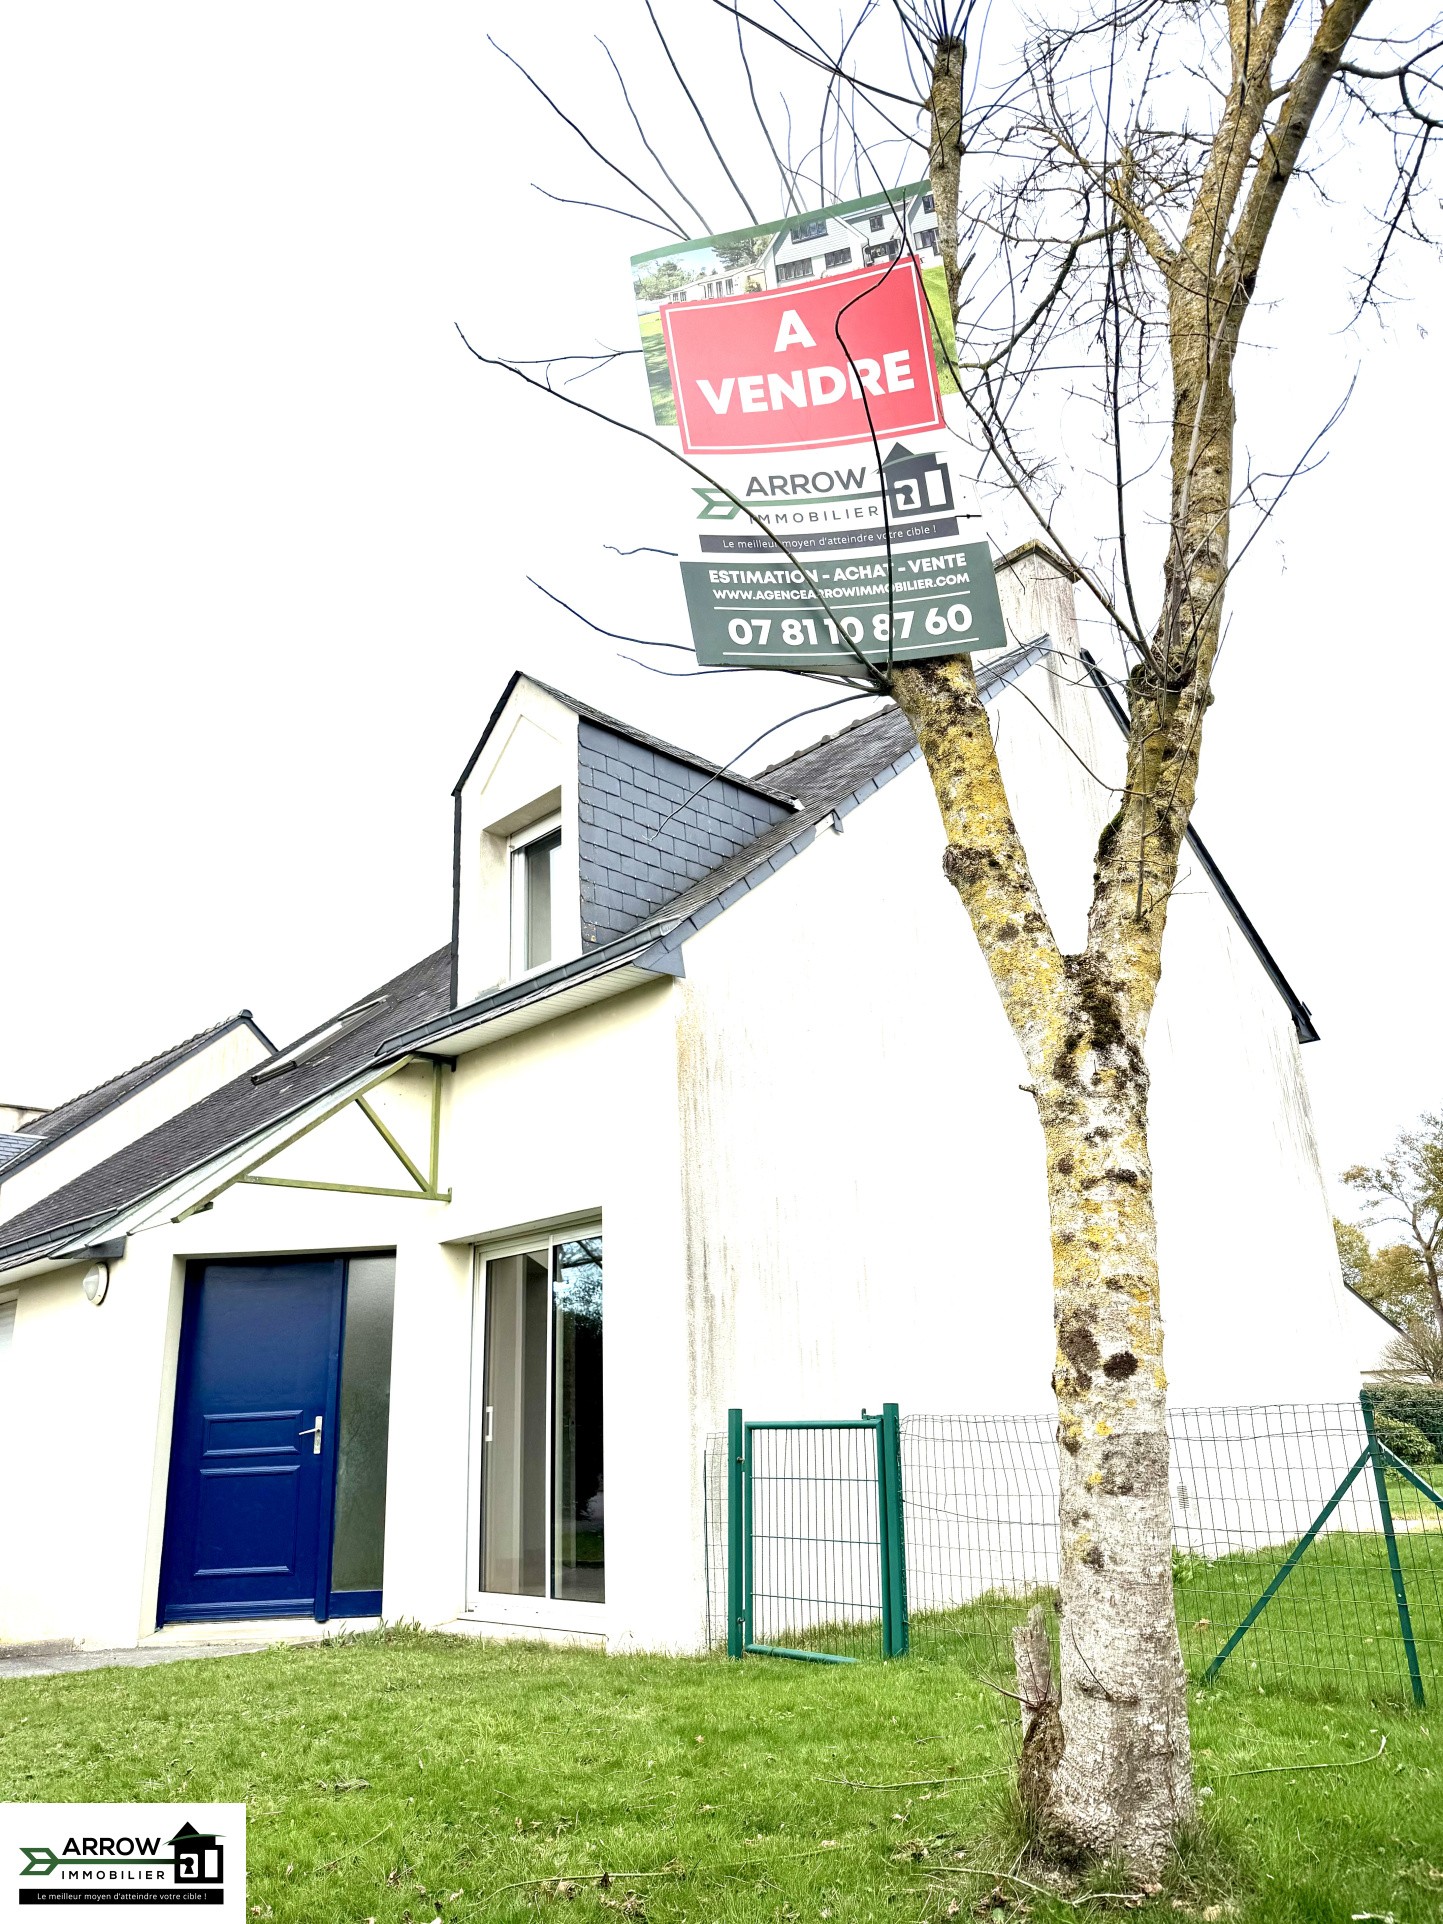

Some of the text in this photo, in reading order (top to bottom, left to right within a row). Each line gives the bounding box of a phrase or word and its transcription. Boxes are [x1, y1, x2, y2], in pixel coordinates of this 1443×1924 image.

[773, 309, 817, 353] A
[695, 350, 915, 415] VENDRE
[745, 466, 867, 497] ARROW
[749, 505, 879, 525] IMMOBILIER
[722, 539, 735, 548] Le
[781, 539, 816, 550] moyen
[819, 533, 874, 546] d'atteindre
[906, 525, 931, 538] cible
[708, 569, 819, 584] ESTIMATION
[907, 552, 967, 574] VENTE
[727, 603, 973, 646] 07 81 10 87 60
